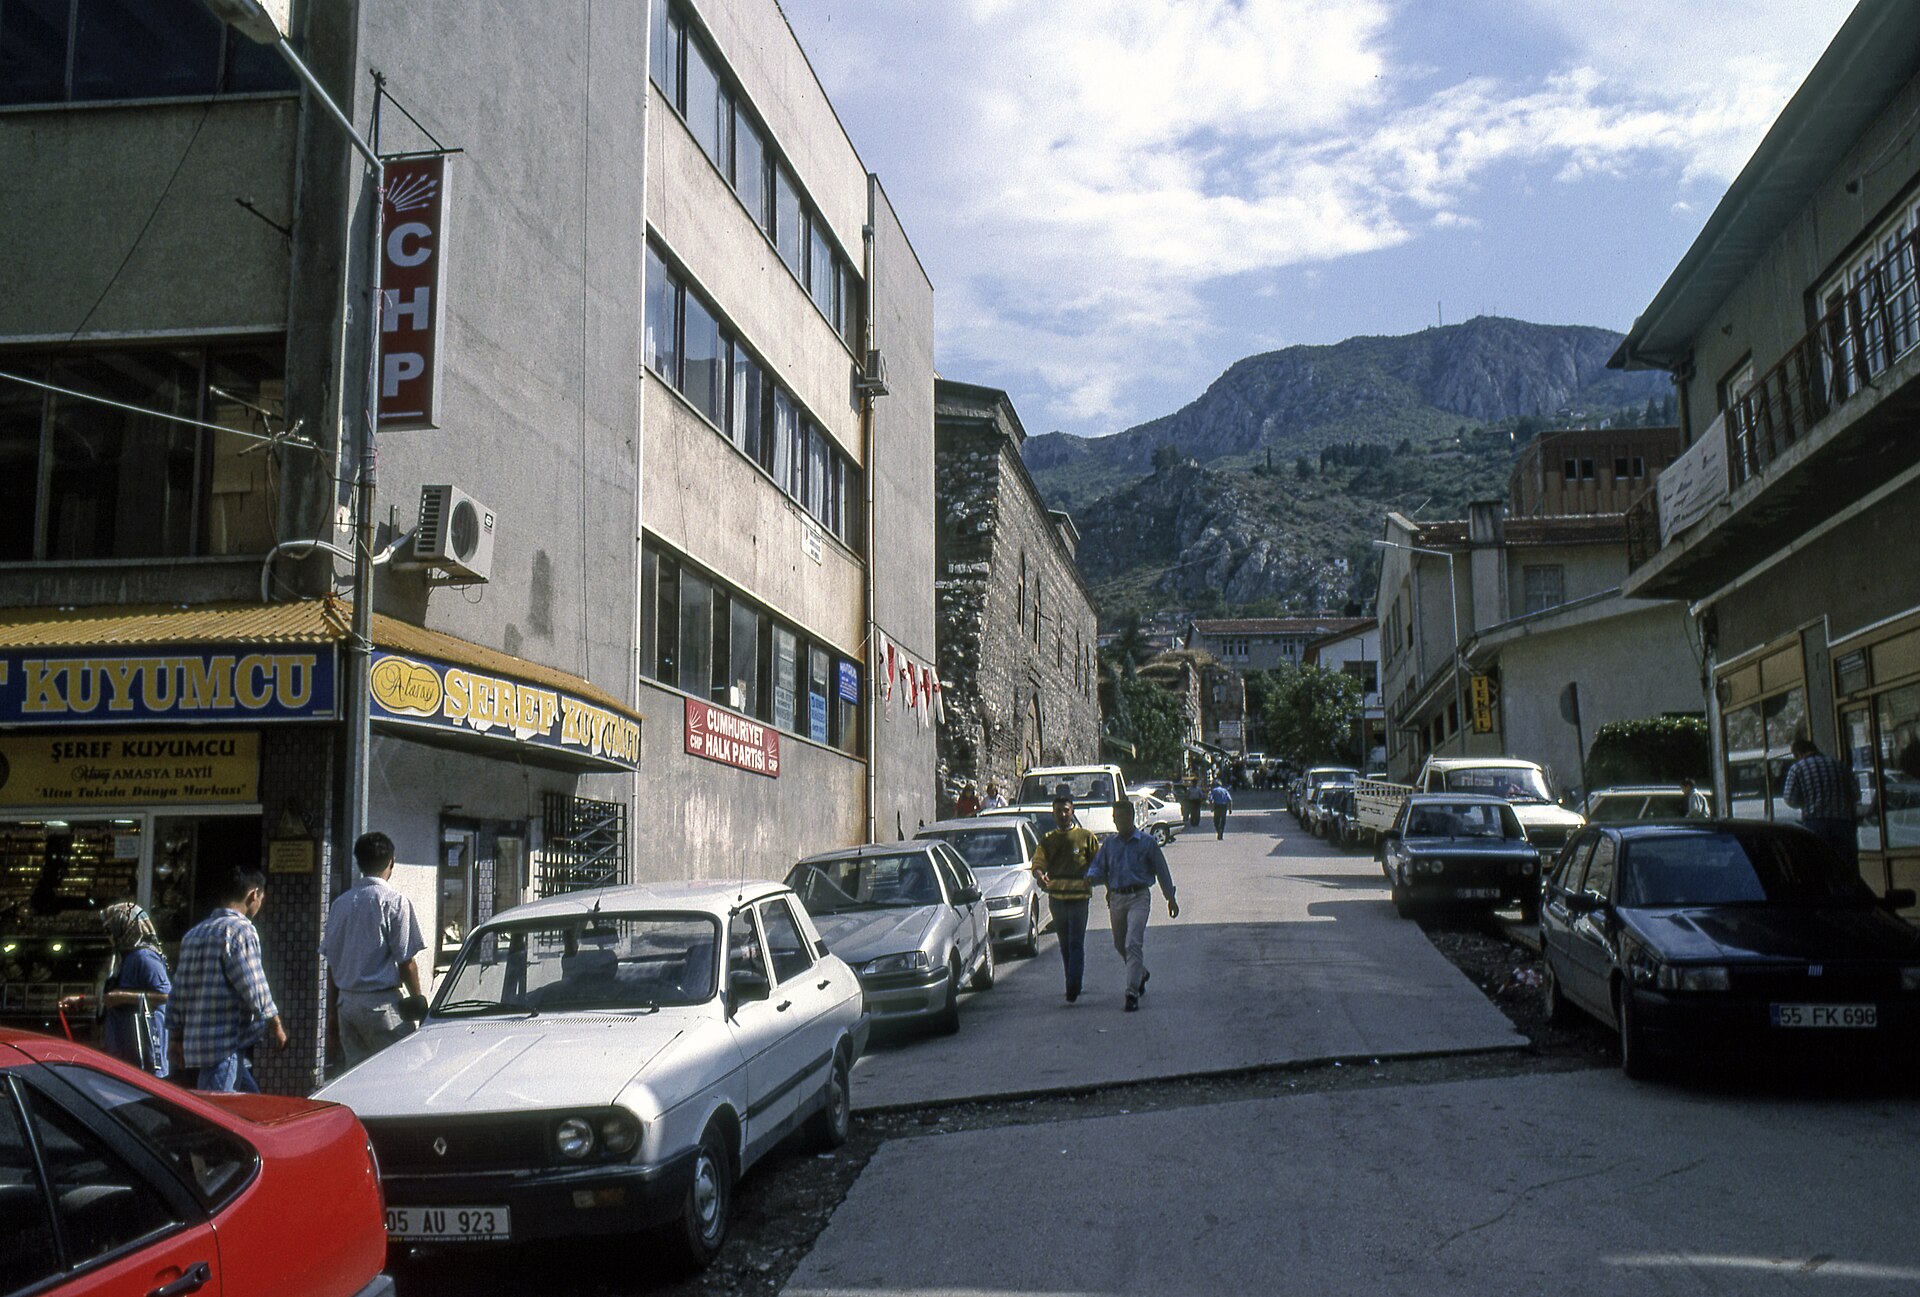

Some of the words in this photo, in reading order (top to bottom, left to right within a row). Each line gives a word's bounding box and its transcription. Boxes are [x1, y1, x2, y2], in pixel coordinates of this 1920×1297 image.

[382, 222, 432, 397] CHP
[21, 655, 316, 713] KUYUMCU
[443, 668, 560, 738] ŞEREF
[560, 696, 640, 763] KUYUMCU
[1473, 678, 1490, 730] TEKEL
[690, 734, 703, 750] CHP
[706, 708, 764, 747] CUMHURİYET
[51, 741, 112, 763] ŞEREF
[122, 740, 236, 758] KUYUMCU
[705, 733, 731, 762] HALK
[732, 742, 766, 771] PARTİSİ
[768, 758, 778, 772] CHP
[112, 767, 170, 780] AMASYA
[1780, 1007, 1802, 1025] 55
[1813, 1008, 1839, 1026] FK
[387, 1211, 408, 1233] 05
[423, 1211, 446, 1233] AU
[459, 1211, 495, 1233] 923
